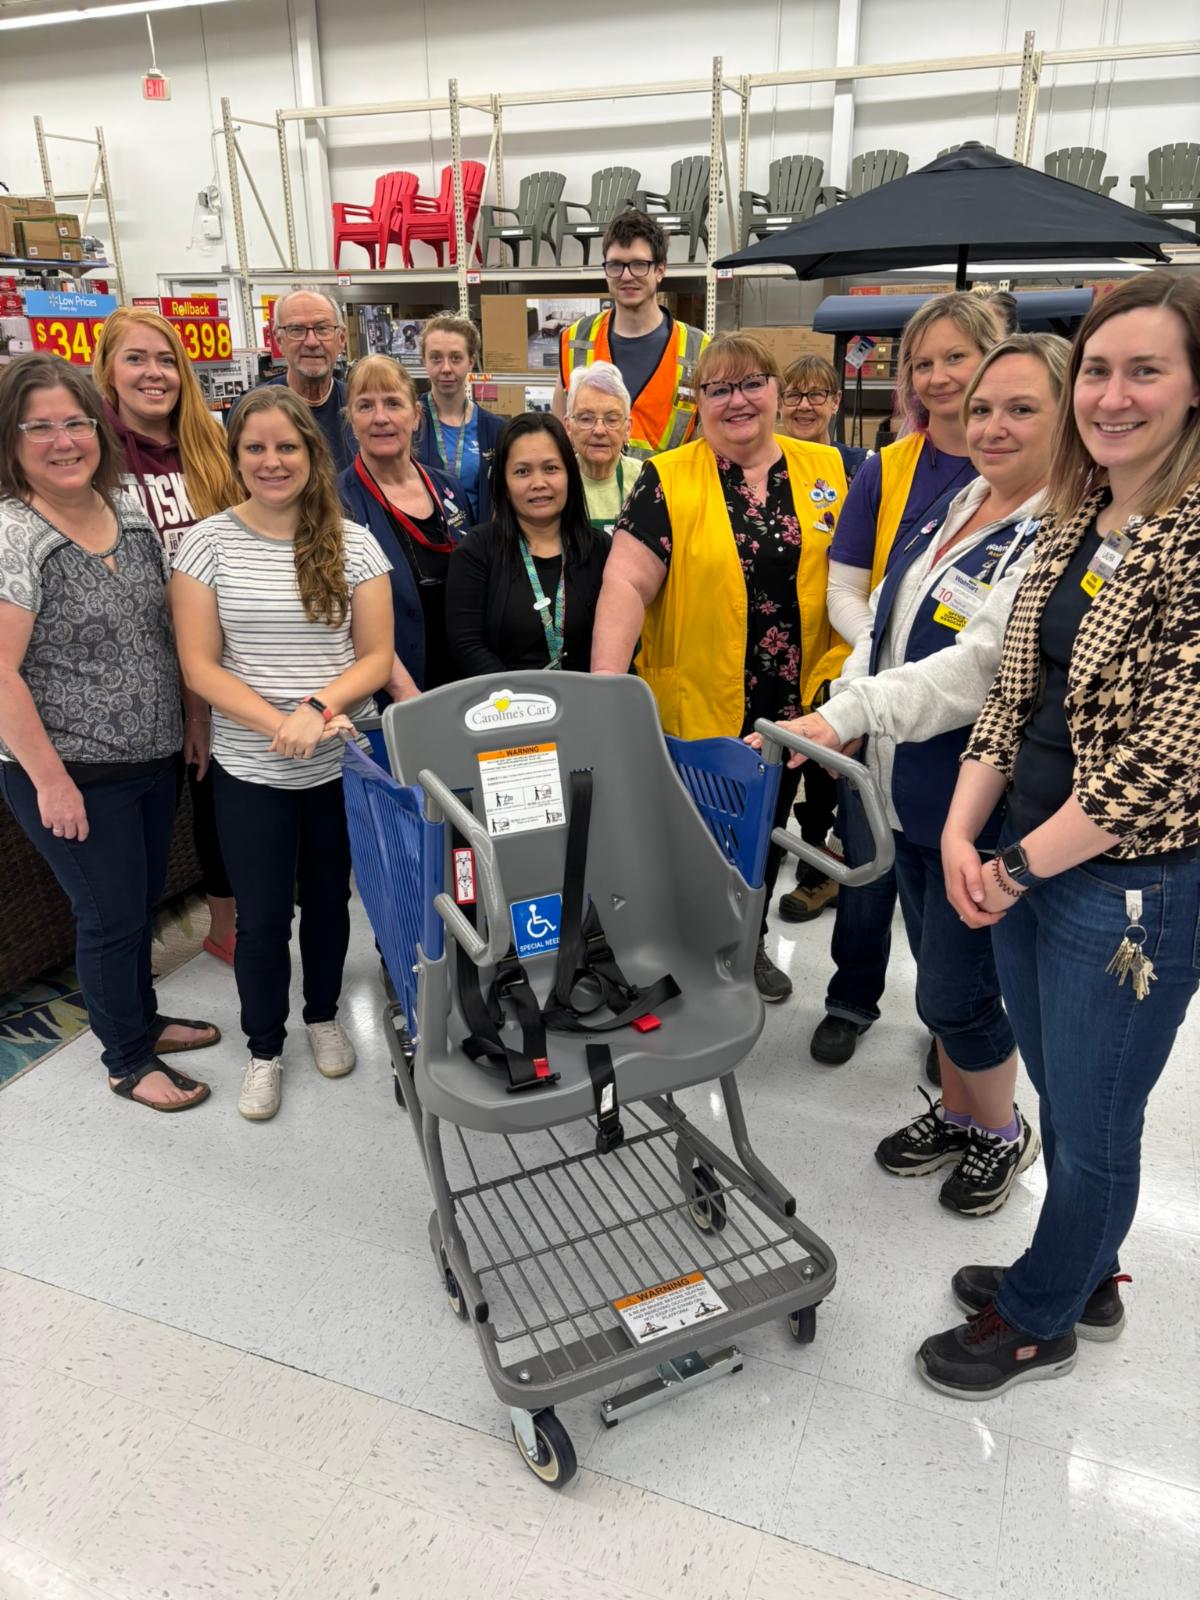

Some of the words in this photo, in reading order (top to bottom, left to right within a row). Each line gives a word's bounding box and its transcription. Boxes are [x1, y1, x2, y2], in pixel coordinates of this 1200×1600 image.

[146, 79, 165, 97] EXIT
[58, 295, 74, 305] Low
[75, 295, 97, 307] Prices
[171, 301, 210, 316] Rollback
[954, 575, 979, 593] Walmart
[938, 587, 953, 603] 10
[472, 705, 525, 725] Caroline's
[526, 703, 552, 717] Cart
[506, 745, 540, 757] WARNING
[519, 941, 544, 953] SPECIAL
[636, 1278, 689, 1300] WARNING
